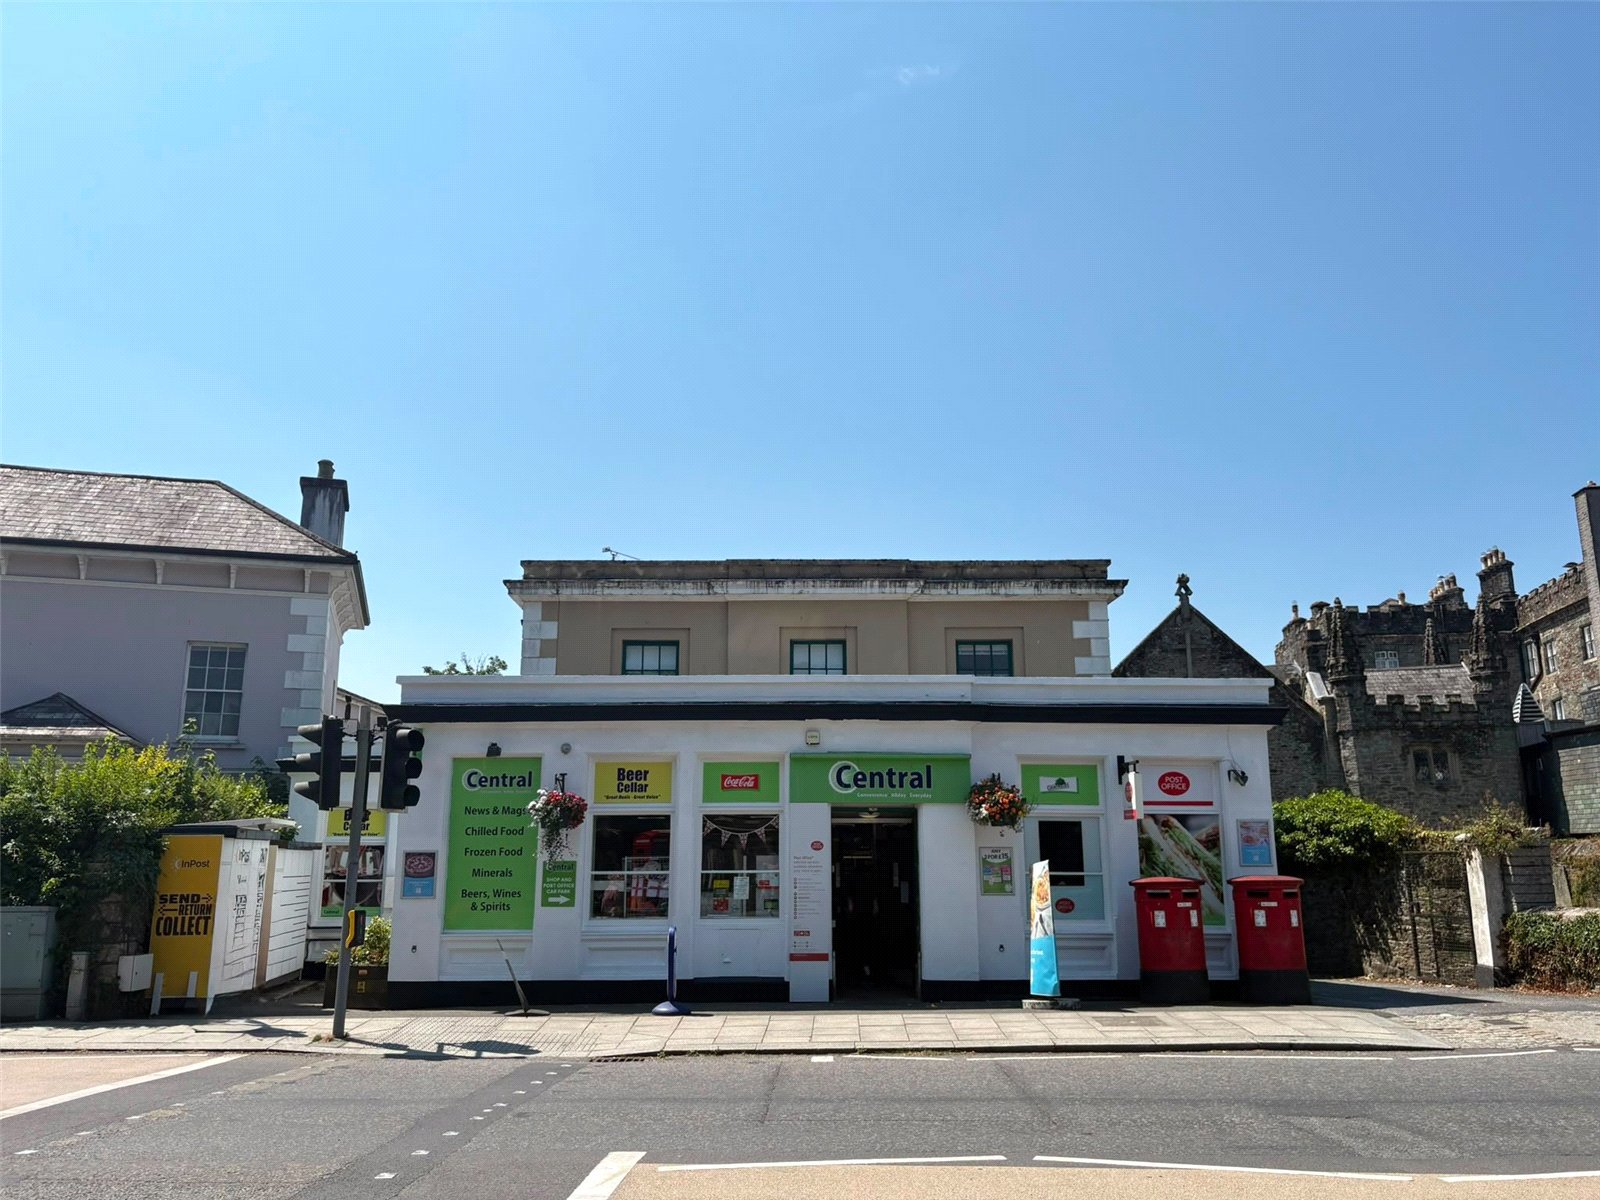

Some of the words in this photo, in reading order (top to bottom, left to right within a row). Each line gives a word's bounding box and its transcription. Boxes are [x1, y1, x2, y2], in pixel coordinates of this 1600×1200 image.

[467, 771, 532, 788] Central
[617, 768, 649, 781] Beer
[836, 764, 932, 789] Central
[617, 782, 648, 793] Cellar
[464, 806, 490, 815] News
[492, 806, 499, 815] &
[502, 806, 526, 817] Mags
[465, 827, 498, 837] Chilled
[501, 826, 524, 837] Food
[464, 847, 496, 857] Frozen
[499, 847, 523, 857] Food
[181, 860, 210, 868] InPost
[472, 868, 512, 877] Minerals
[160, 893, 201, 904] SEND
[461, 889, 490, 899] Beers,
[493, 888, 521, 898] Wines
[178, 903, 213, 916] RETURN
[471, 902, 478, 911] &
[480, 902, 511, 912] Spirits
[155, 915, 211, 936] COLLECT
